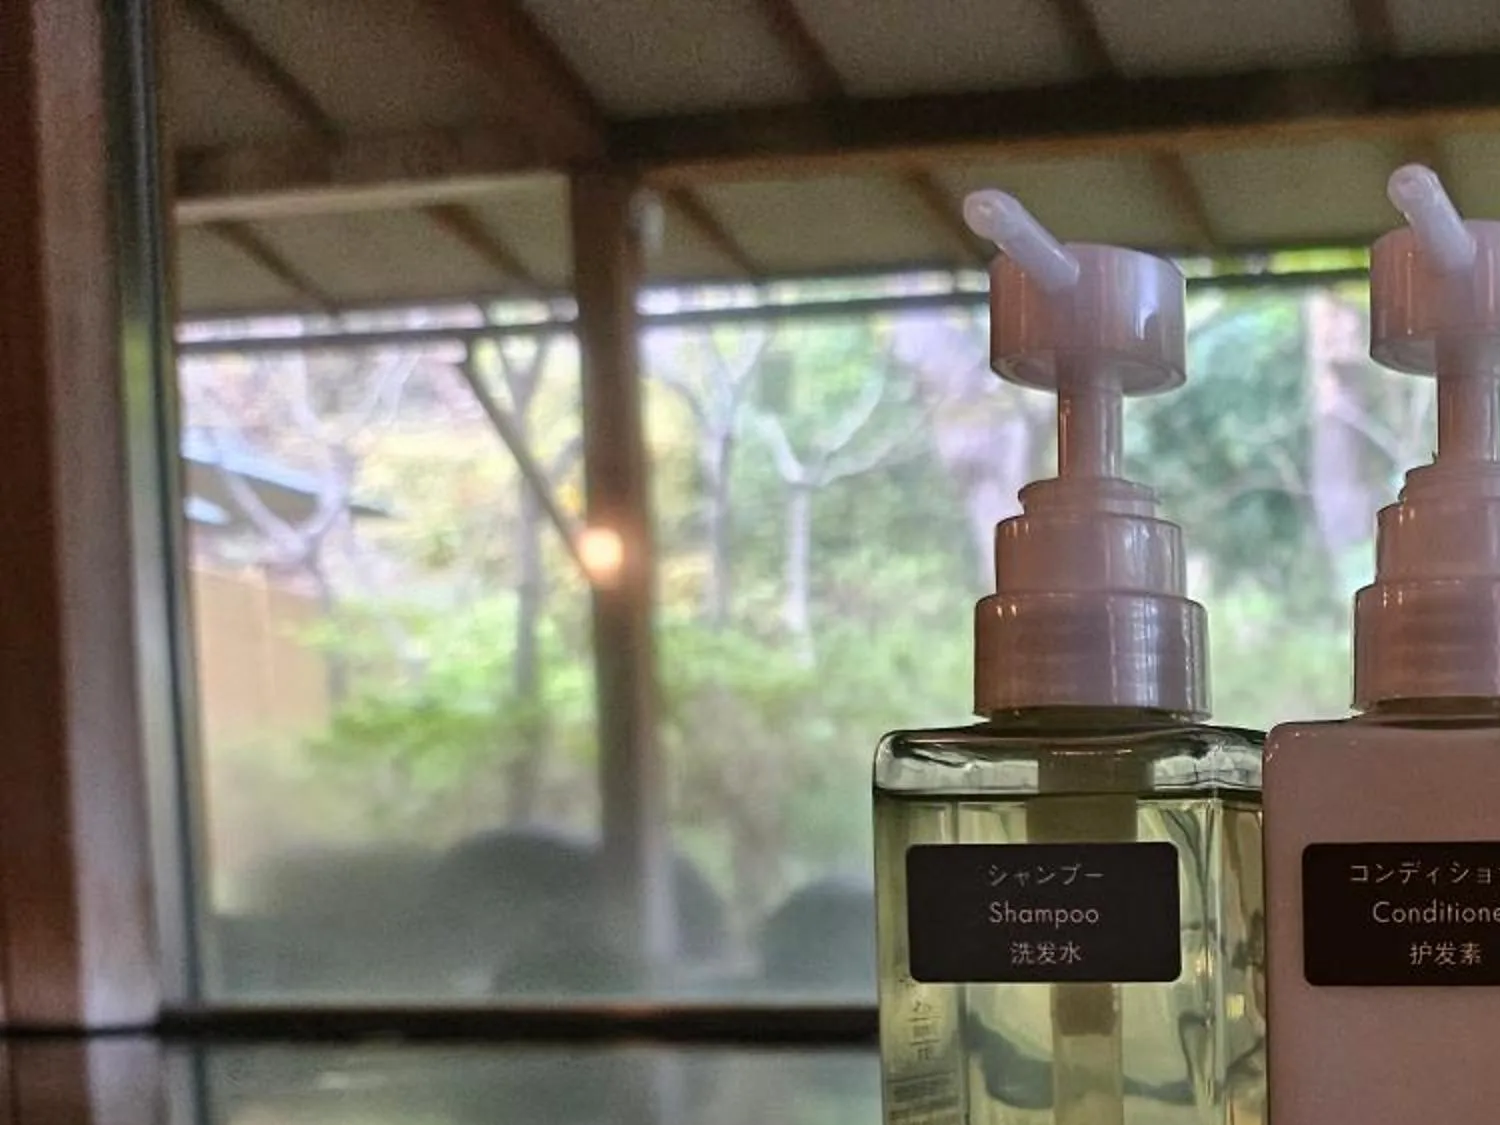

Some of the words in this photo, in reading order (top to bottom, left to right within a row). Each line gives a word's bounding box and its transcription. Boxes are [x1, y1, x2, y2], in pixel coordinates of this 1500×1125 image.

[987, 863, 1104, 886] シャンプー
[988, 901, 1100, 929] Shampoo
[1011, 941, 1082, 965] 洗发水
[1409, 941, 1482, 966] 护发素
